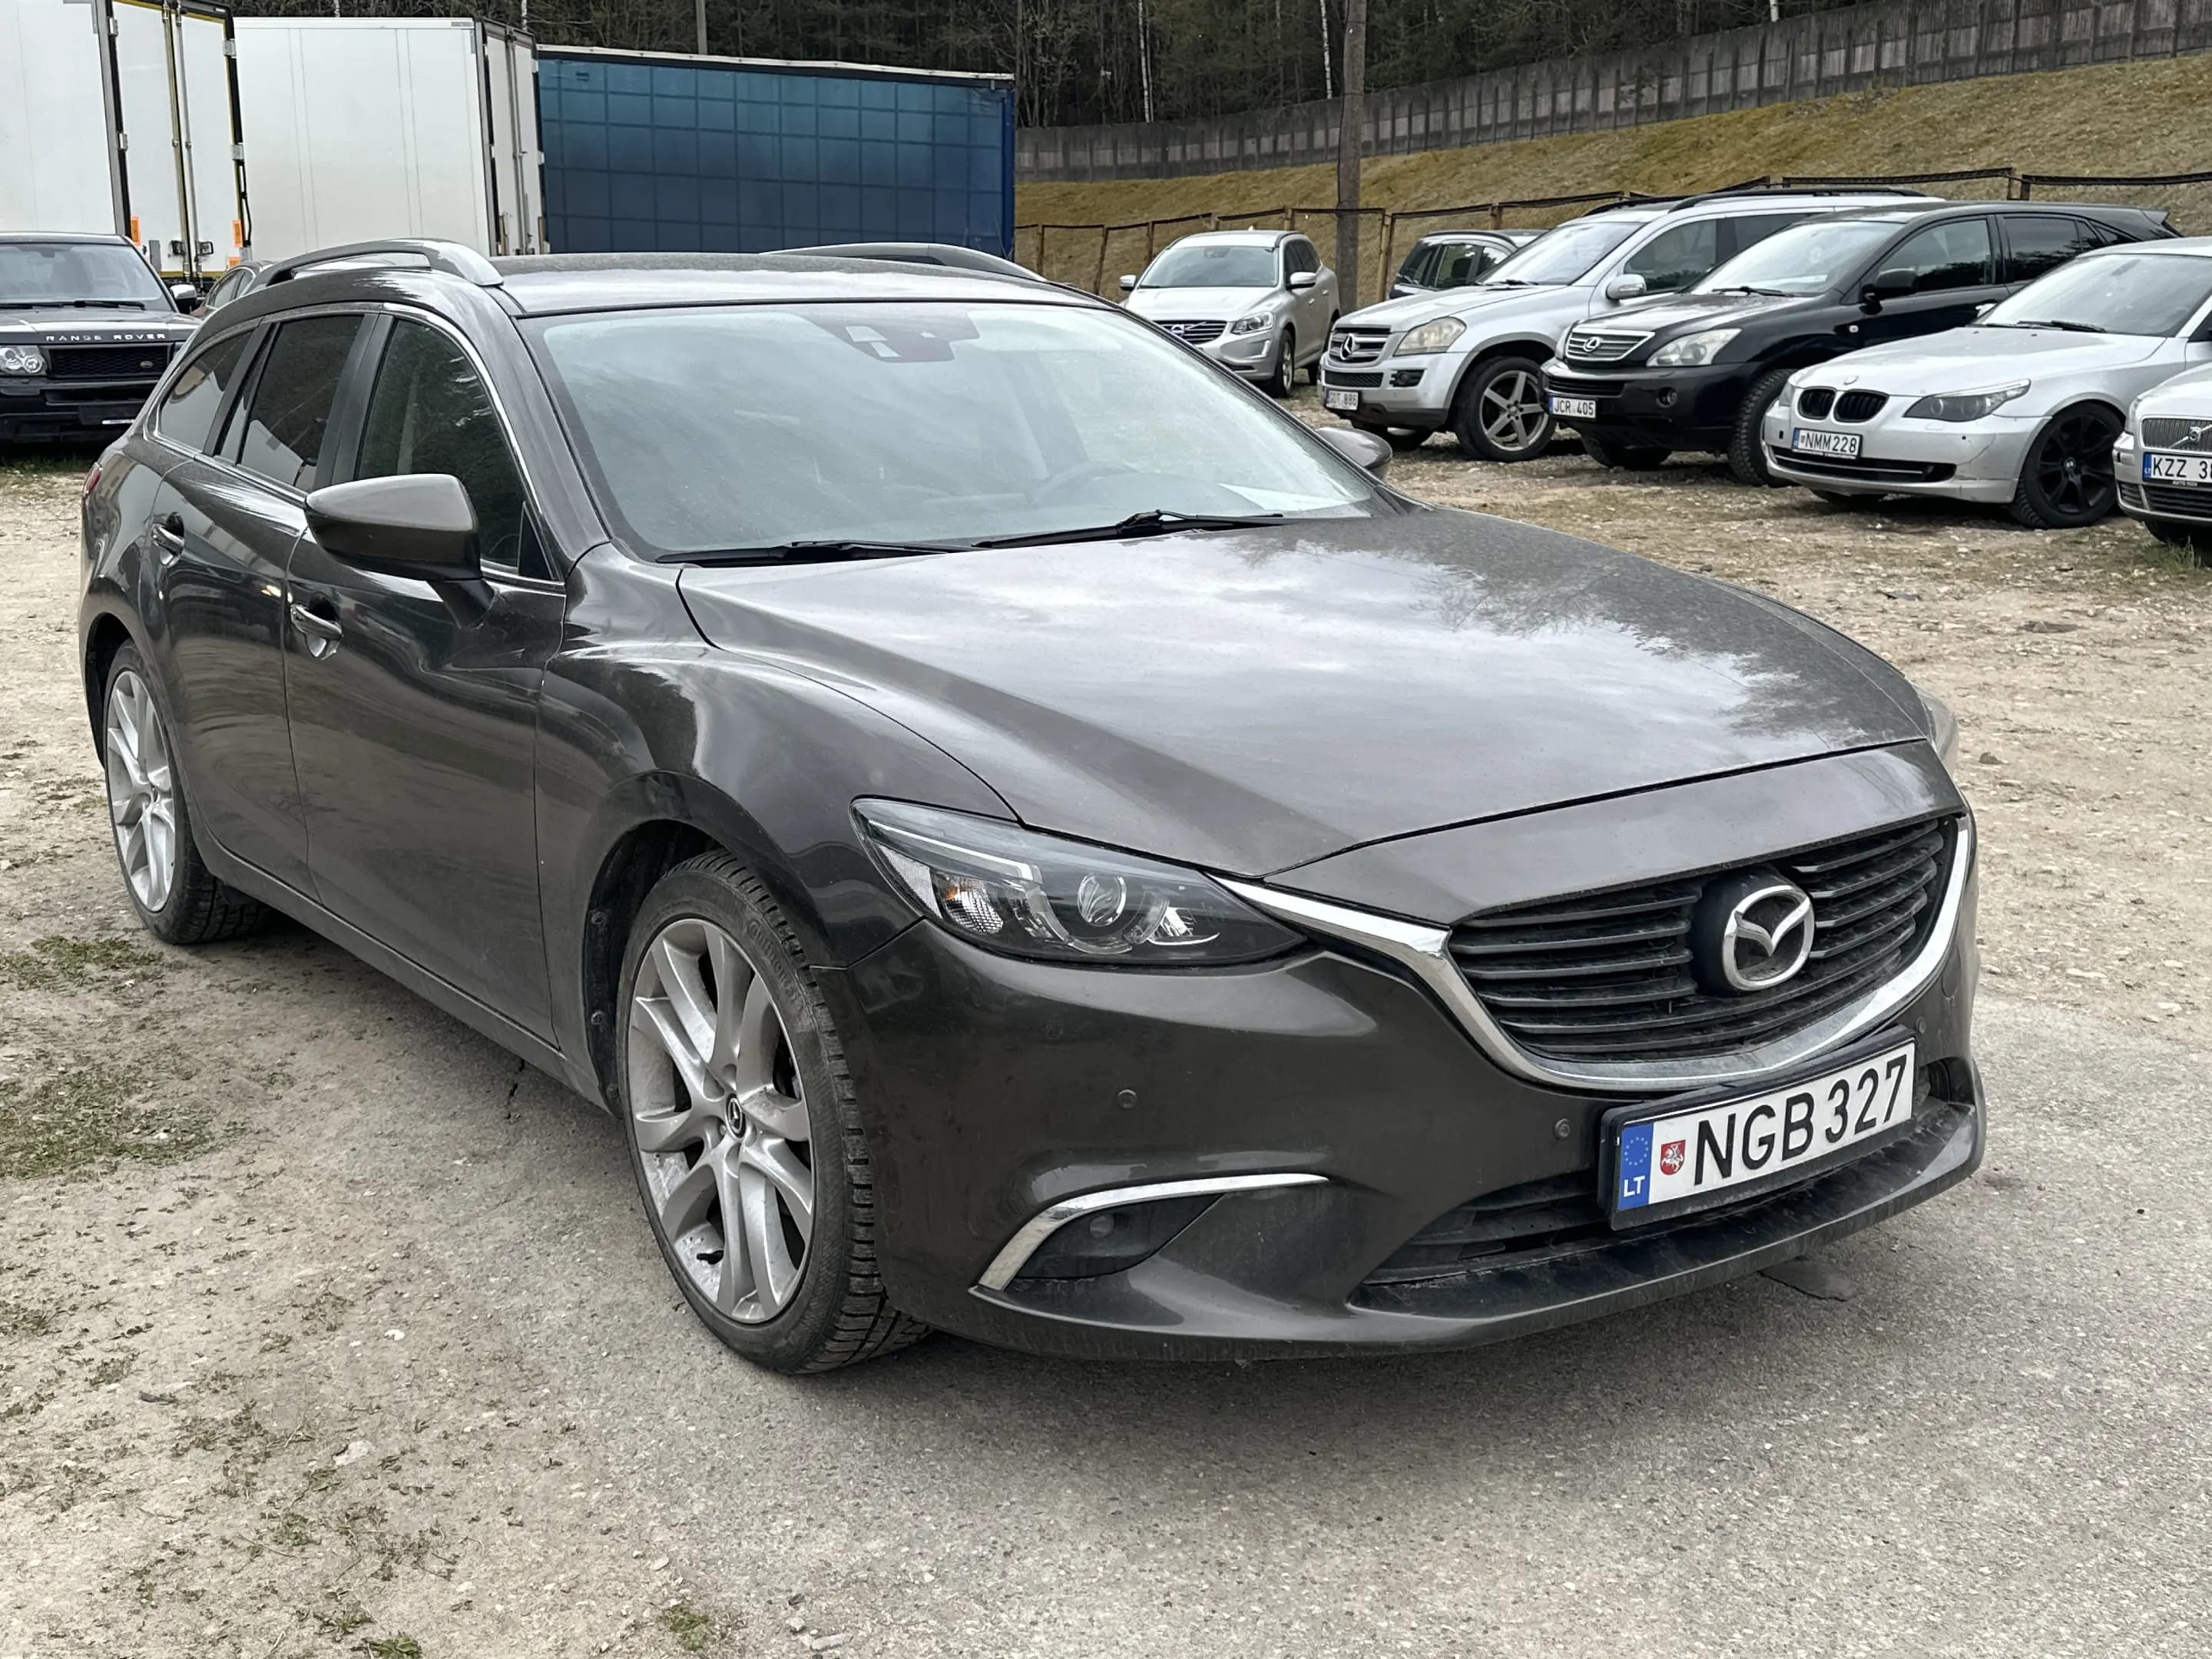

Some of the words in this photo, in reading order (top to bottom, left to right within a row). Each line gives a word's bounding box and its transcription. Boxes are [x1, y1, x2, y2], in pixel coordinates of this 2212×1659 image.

[1555, 399, 1571, 414] JCR
[1577, 401, 1594, 416] 405
[1805, 432, 1857, 453] NMM228
[2153, 457, 2187, 478] KZZ
[2199, 460, 2212, 479] 3
[1623, 1175, 1646, 1198] LT
